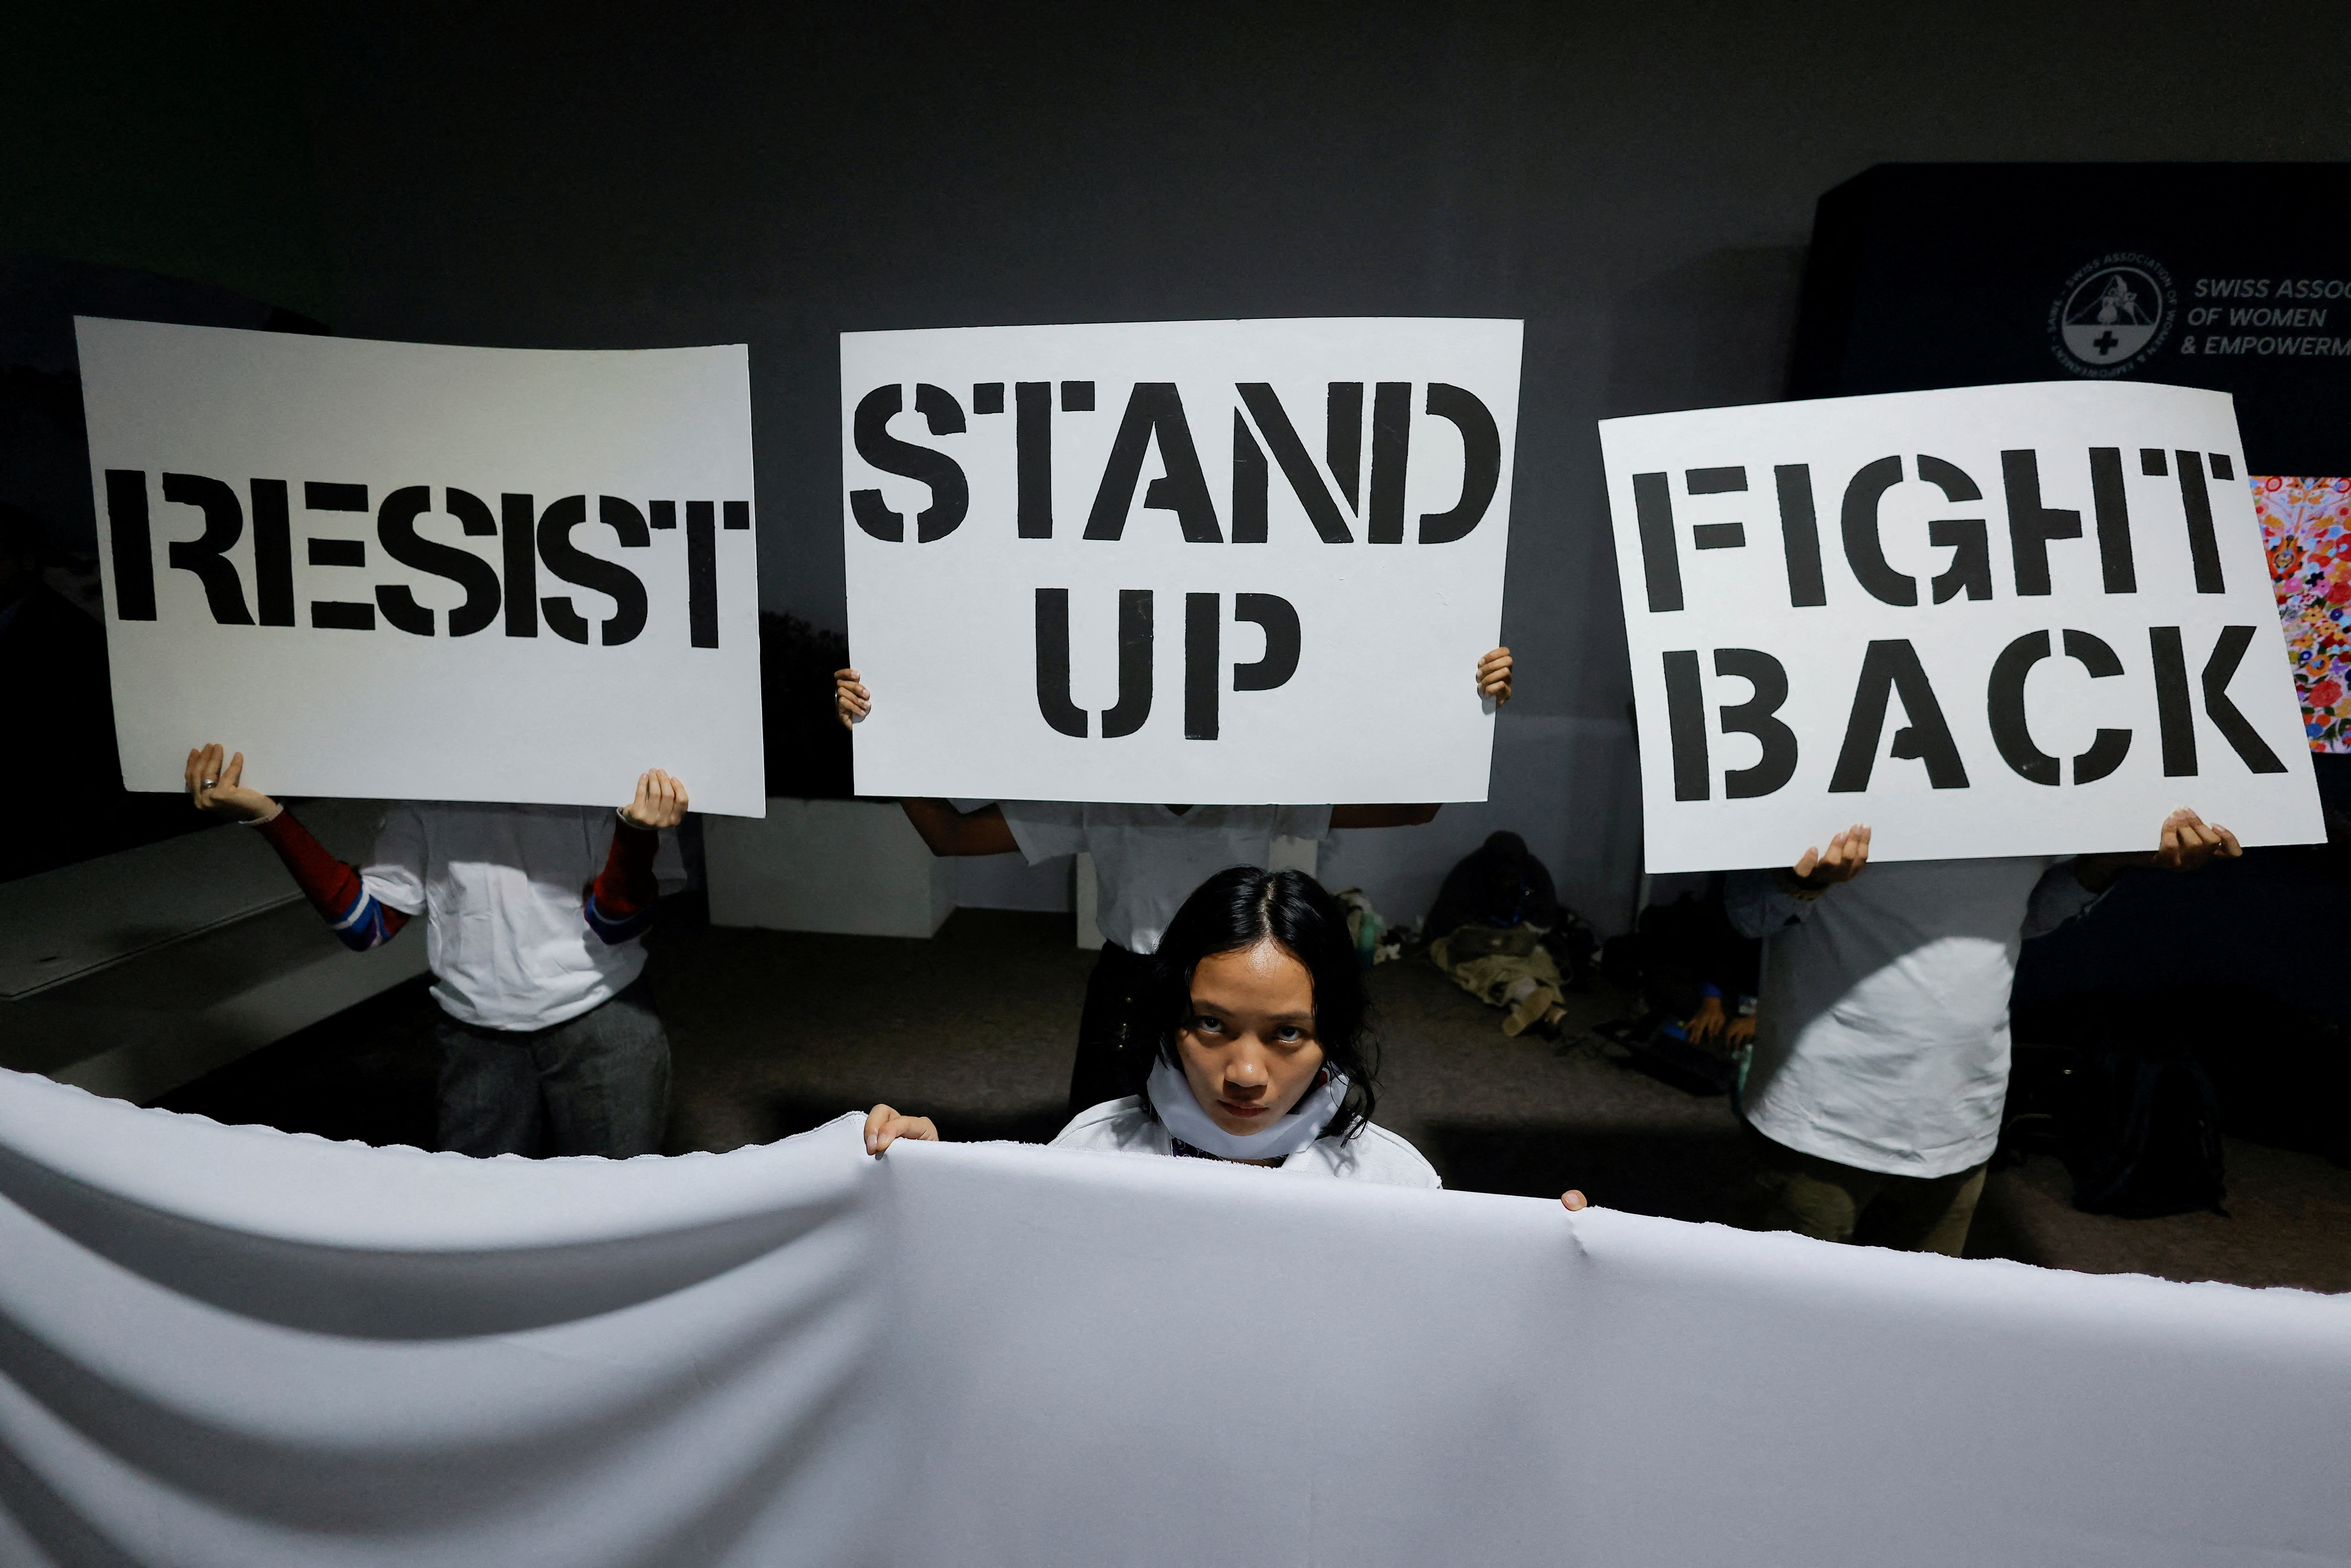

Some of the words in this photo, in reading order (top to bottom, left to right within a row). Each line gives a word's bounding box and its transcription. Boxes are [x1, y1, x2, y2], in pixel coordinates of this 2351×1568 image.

[2103, 252, 2173, 288] ASSOCIATION
[2194, 279, 2271, 298] SWISS
[2167, 289, 2178, 305] OF
[2187, 307, 2223, 326] OF
[2229, 308, 2327, 327] WOMEN
[2146, 309, 2176, 355] WOMEN
[2180, 335, 2196, 354] &
[2203, 336, 2351, 356] EMPOWERM
[850, 381, 1501, 544] STAND
[1633, 447, 2235, 613] FIGHT
[103, 466, 750, 650] RESIST
[1035, 588, 1301, 741] UP
[1662, 625, 2289, 802] BACK
